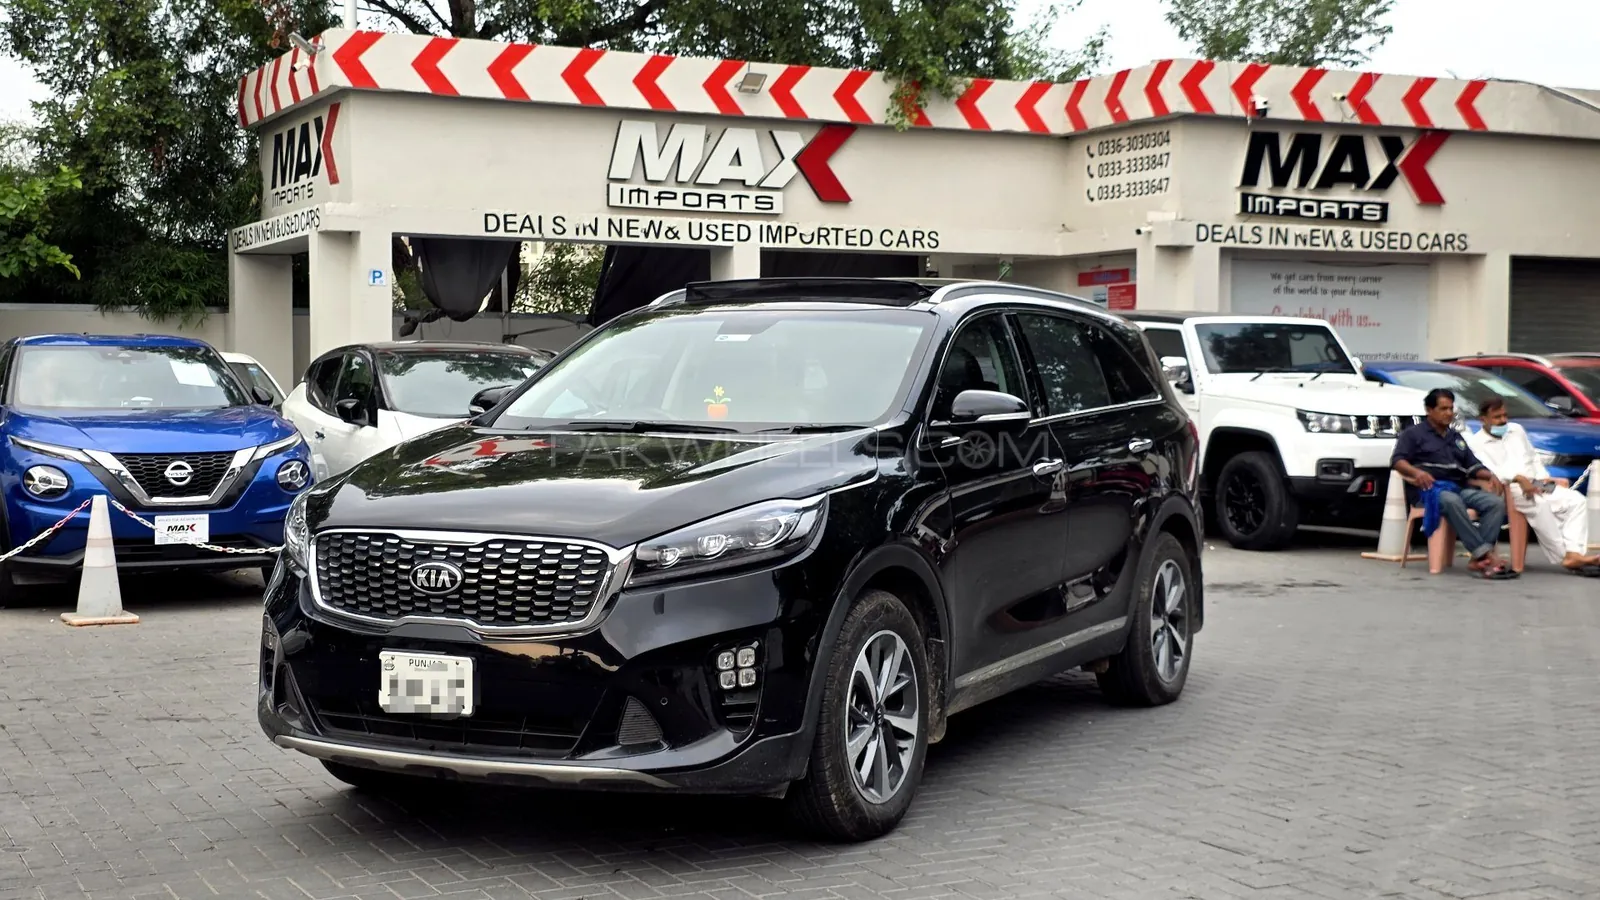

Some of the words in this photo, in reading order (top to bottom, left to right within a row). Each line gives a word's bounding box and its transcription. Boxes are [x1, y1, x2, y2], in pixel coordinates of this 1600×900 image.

[271, 102, 341, 190] MAX
[1097, 130, 1171, 157] 0336-3030304
[607, 119, 858, 203] MAX
[1097, 152, 1170, 178] 0333-3333847
[1239, 130, 1451, 205] MAX
[271, 181, 314, 208] IMPORTS
[619, 187, 774, 211] IMPORTS
[1247, 195, 1383, 221] IMPORTS
[233, 226, 253, 250] DEALS
[254, 222, 261, 244] IN
[282, 213, 299, 237] USED
[300, 207, 320, 232] CARS
[484, 213, 567, 237] DEALS
[575, 217, 598, 237] IN
[688, 221, 751, 243] USED
[759, 224, 873, 247] IMPORTED
[879, 229, 939, 249] CARS
[1195, 223, 1262, 245] DEALS
[1268, 227, 1289, 246] IN
[1360, 231, 1412, 251] USED
[1416, 233, 1468, 251] CARS
[372, 270, 383, 284] P
[1270, 272, 1281, 281] We
[1284, 272, 1296, 285] get
[1299, 273, 1314, 281] cars
[1317, 272, 1334, 282] from
[1273, 284, 1281, 295] of
[1283, 284, 1295, 294] the
[1298, 285, 1318, 295] world
[1321, 286, 1328, 296] to
[1329, 307, 1352, 327] with
[167, 523, 197, 532] MAX
[416, 569, 452, 588] KIA
[409, 658, 443, 668] PUNJ
